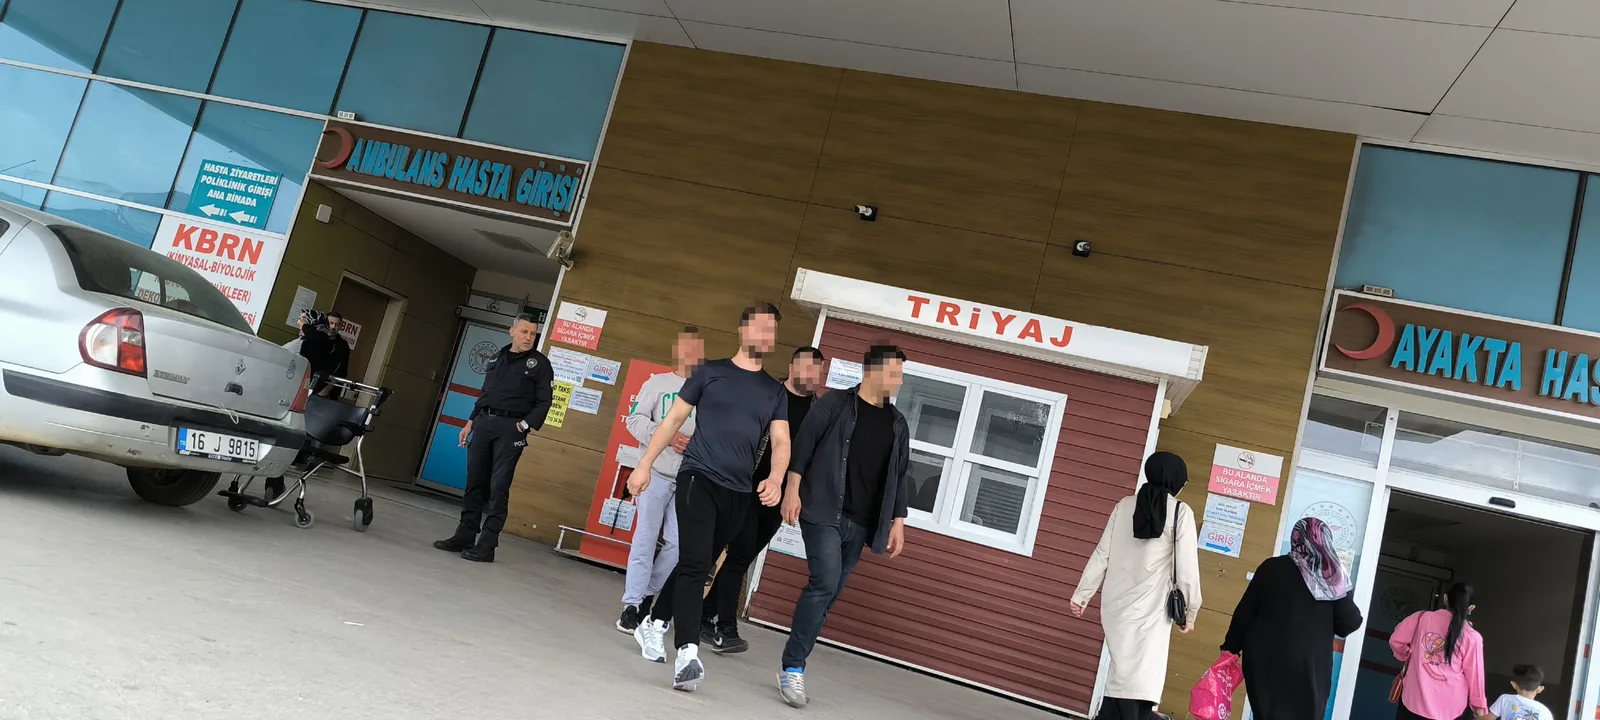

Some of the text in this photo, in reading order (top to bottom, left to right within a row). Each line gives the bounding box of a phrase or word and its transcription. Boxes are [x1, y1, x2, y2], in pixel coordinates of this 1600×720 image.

[203, 163, 280, 185] HASTA ZİYARETLERİ
[346, 138, 584, 217] AMBULANS HASTA GİRİŞİ
[200, 175, 274, 199] POLİKLİNİK GİRİŞİ
[207, 189, 258, 207] ANA BİNADA
[172, 223, 265, 265] KBRN
[557, 327, 596, 342] SİGARA İÇMEK
[563, 320, 594, 333] BU ALANDA
[561, 336, 588, 348] YASAKTIR
[1390, 323, 1522, 391] AYAKTA
[593, 364, 613, 377] GİRİŞ
[191, 432, 206, 450] 16
[213, 436, 222, 453] J
[228, 438, 255, 457] 9815
[1215, 475, 1272, 494] SİGARA İÇMEK
[1222, 467, 1268, 484] BU ALANDA
[1223, 486, 1261, 501] YASAKTIR
[1207, 531, 1235, 547] GİRİŞ
